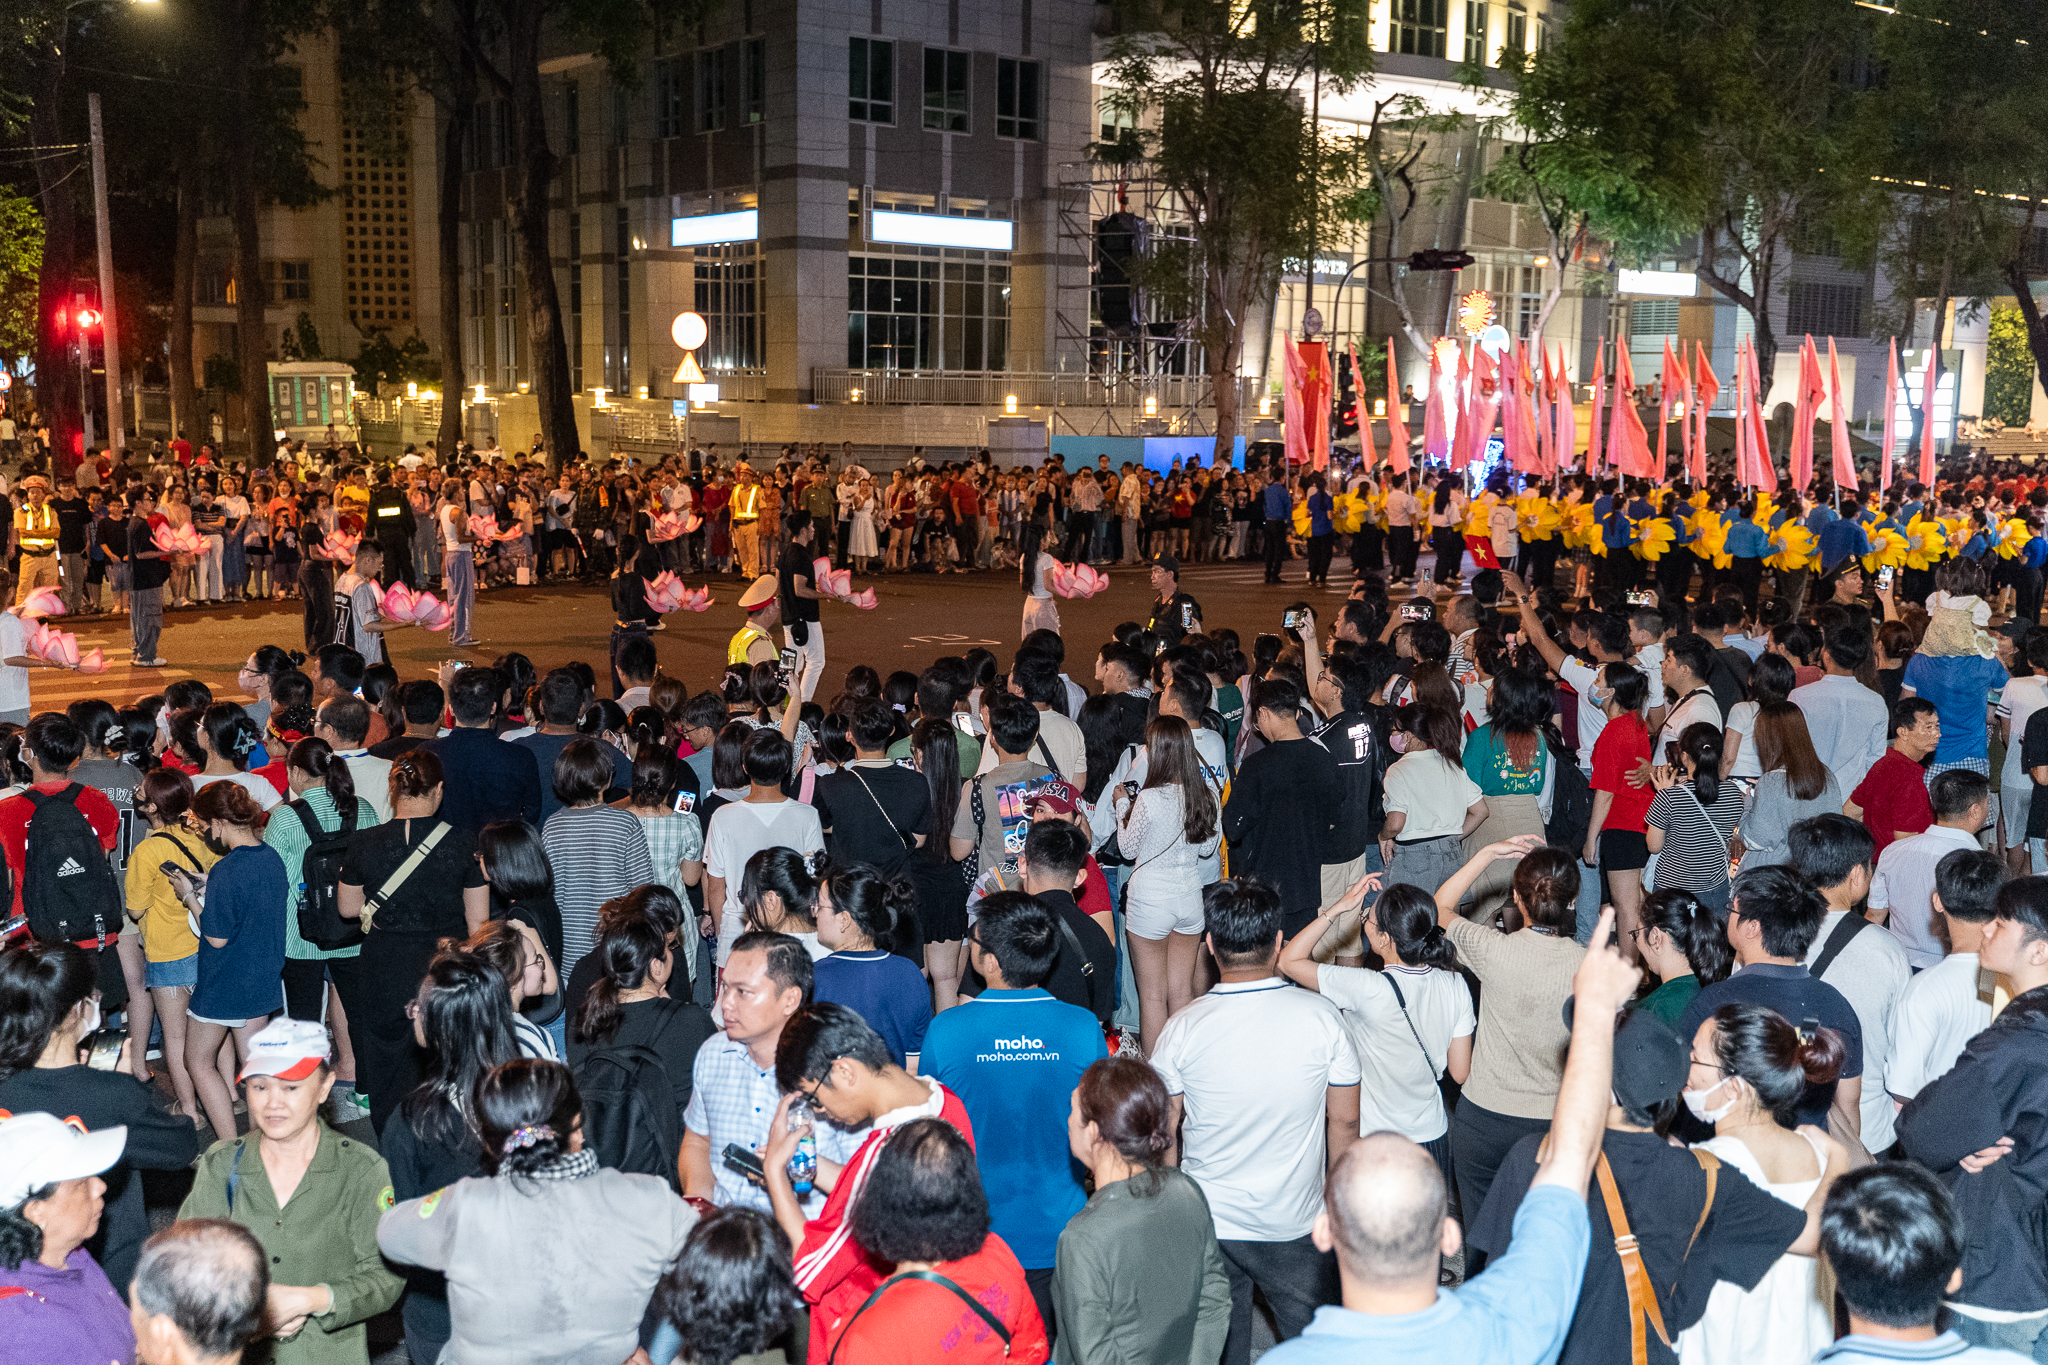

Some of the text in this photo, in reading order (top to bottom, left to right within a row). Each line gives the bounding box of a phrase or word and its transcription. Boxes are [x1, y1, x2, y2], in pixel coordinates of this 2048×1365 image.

[1038, 783, 1070, 803] USA
[57, 866, 86, 878] adidas
[976, 1052, 1060, 1063] moho.com.vn
